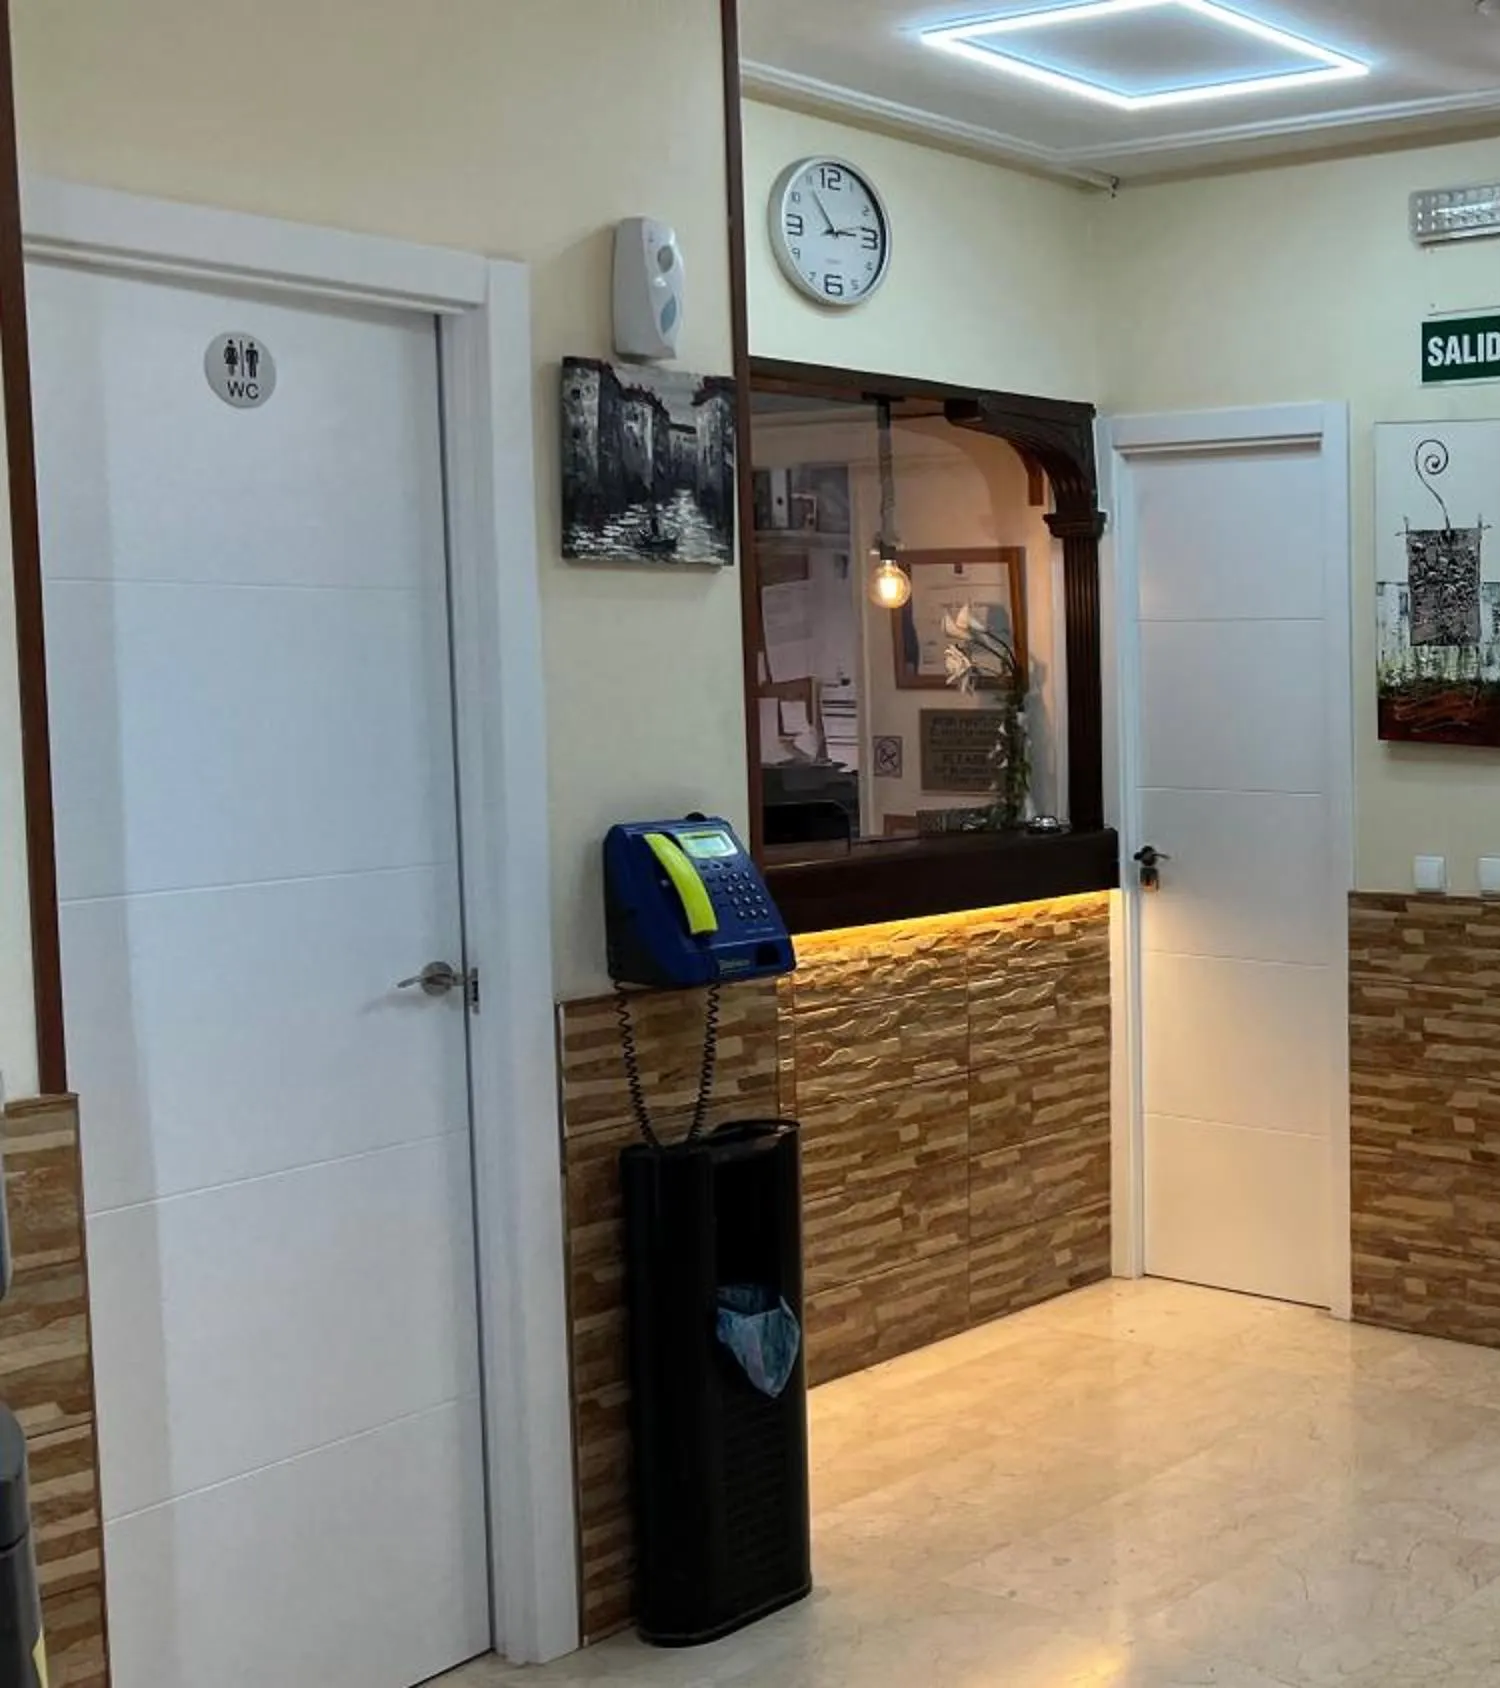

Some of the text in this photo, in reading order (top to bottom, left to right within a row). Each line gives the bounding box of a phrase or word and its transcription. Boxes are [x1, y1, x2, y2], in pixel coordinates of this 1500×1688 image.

[819, 168, 841, 190] 12
[860, 227, 878, 250] 3
[823, 273, 843, 296] 6
[227, 380, 258, 399] WC
